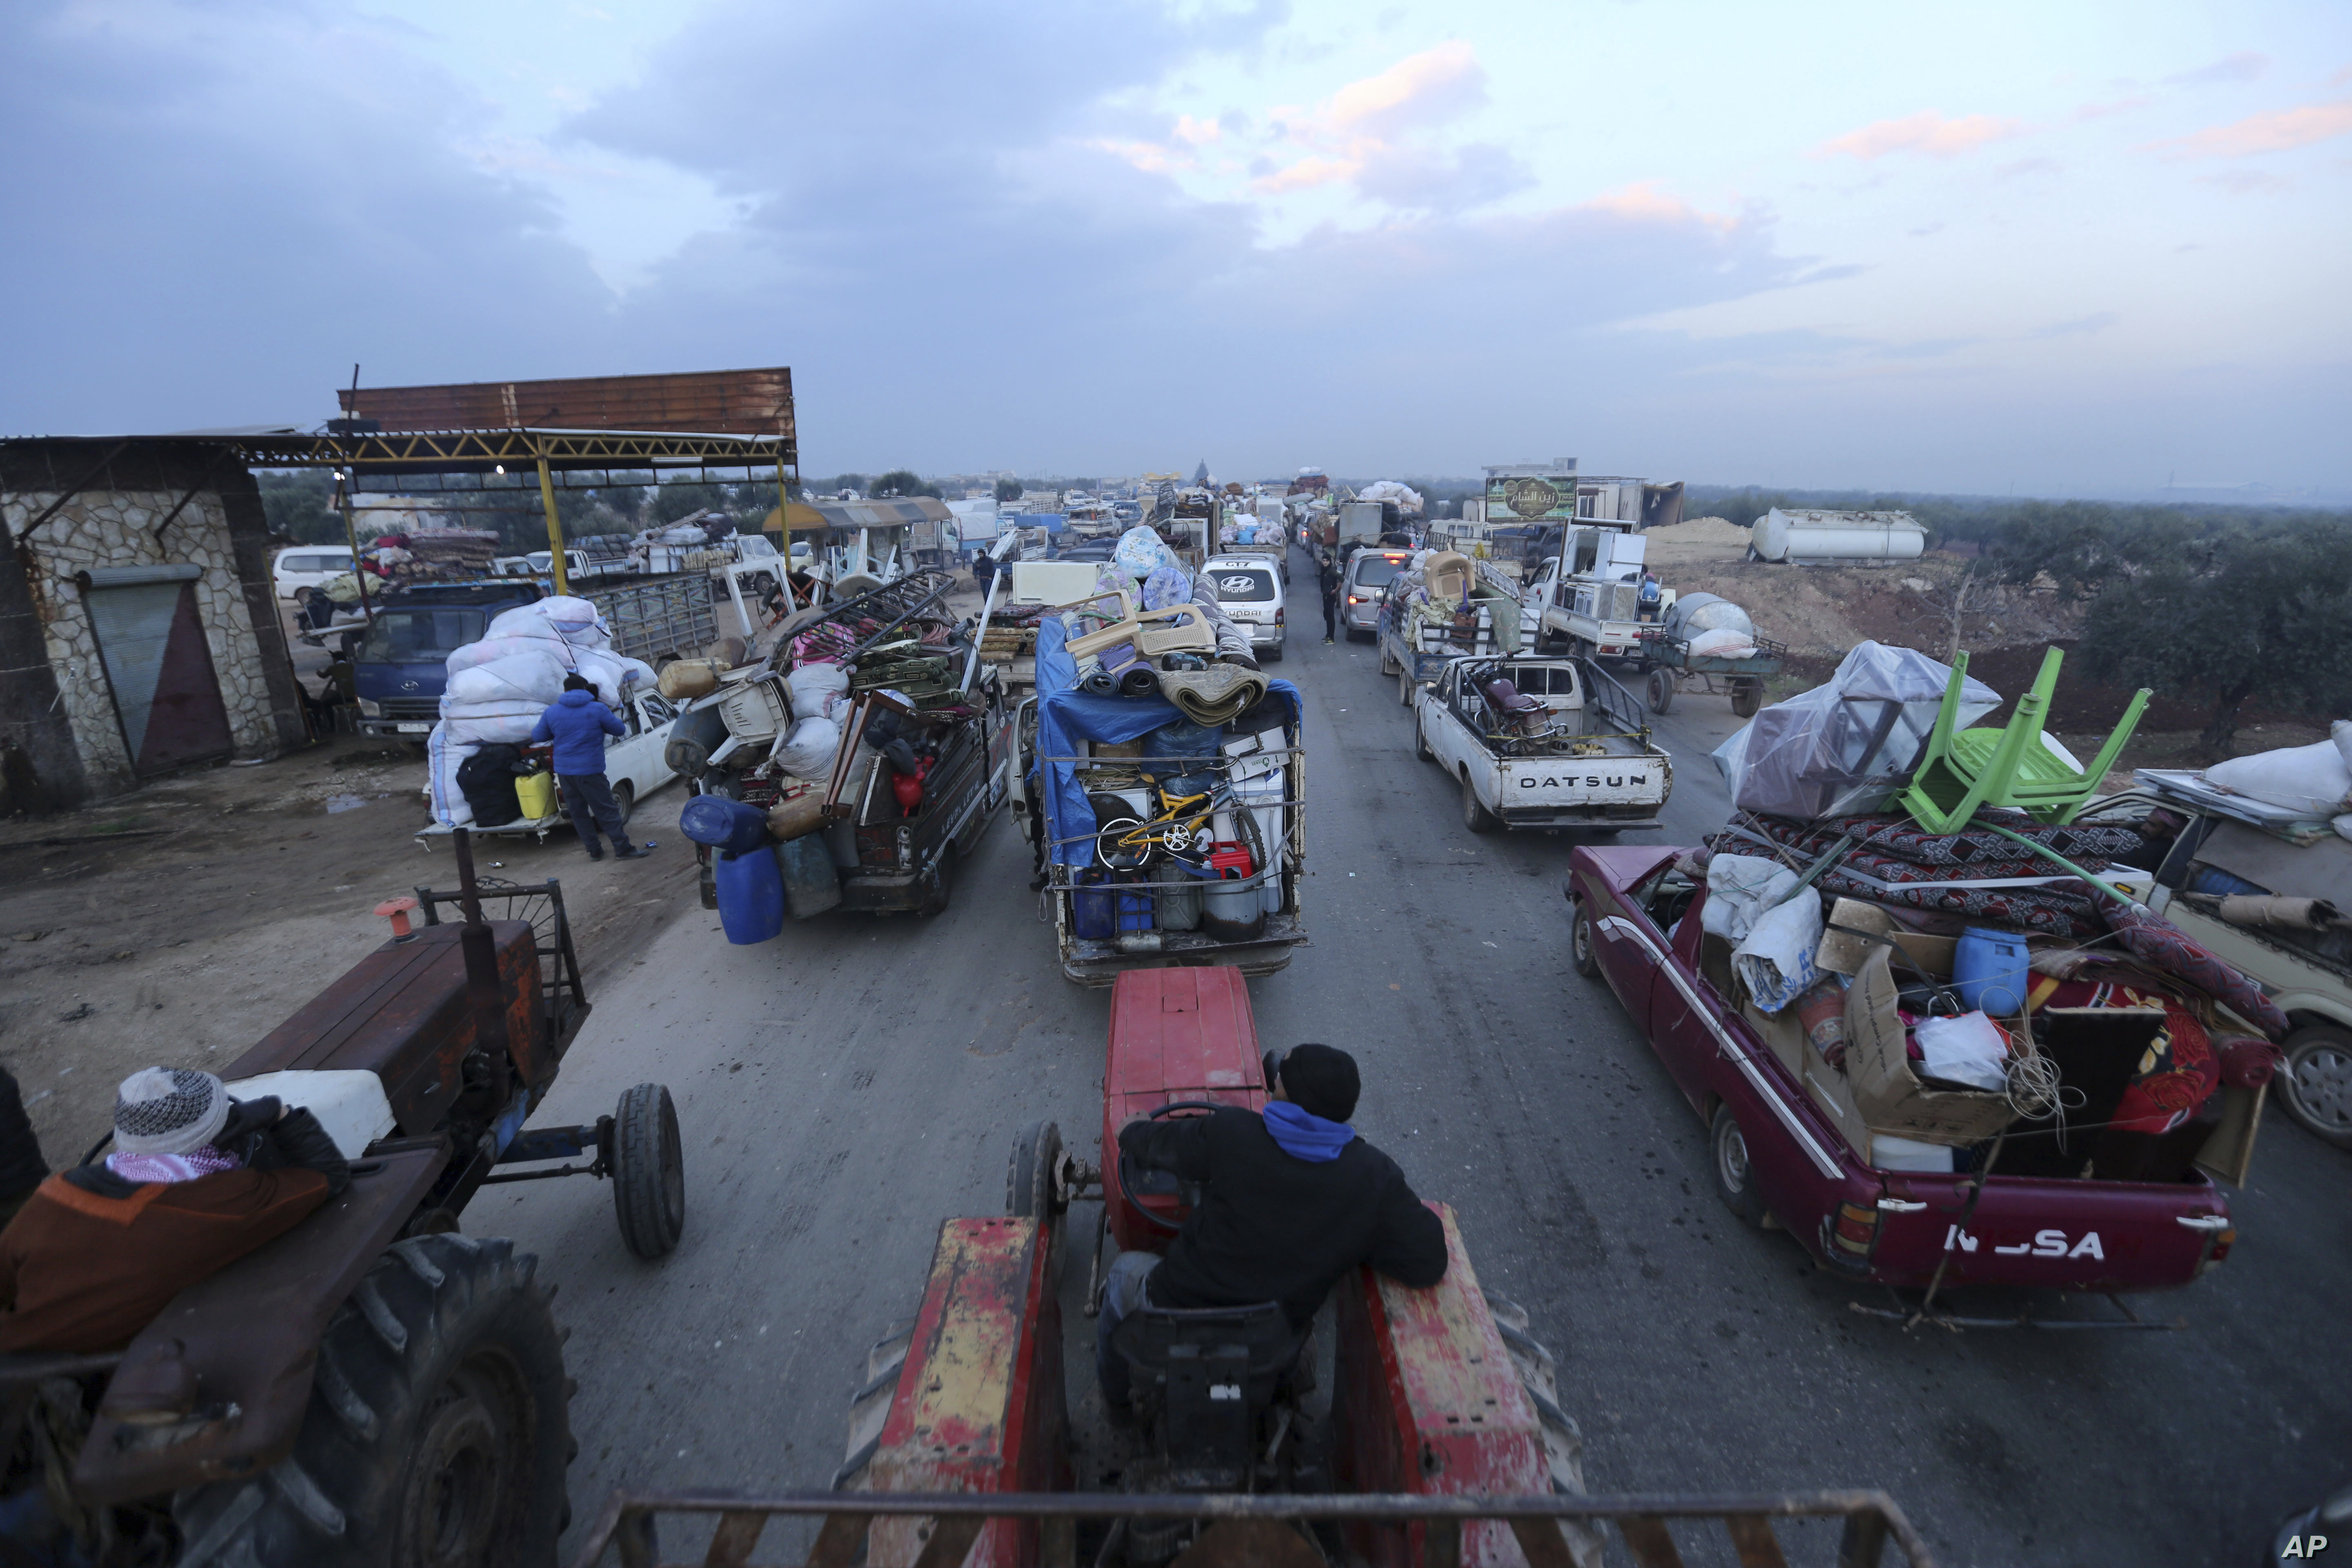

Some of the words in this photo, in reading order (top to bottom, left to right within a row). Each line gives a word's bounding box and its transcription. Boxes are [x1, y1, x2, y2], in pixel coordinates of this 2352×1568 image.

[1511, 489, 1537, 506] الشام
[1539, 491, 1555, 503] زين
[1221, 584, 1255, 593] HYUNDAI
[1520, 775, 1646, 788] DATSUN
